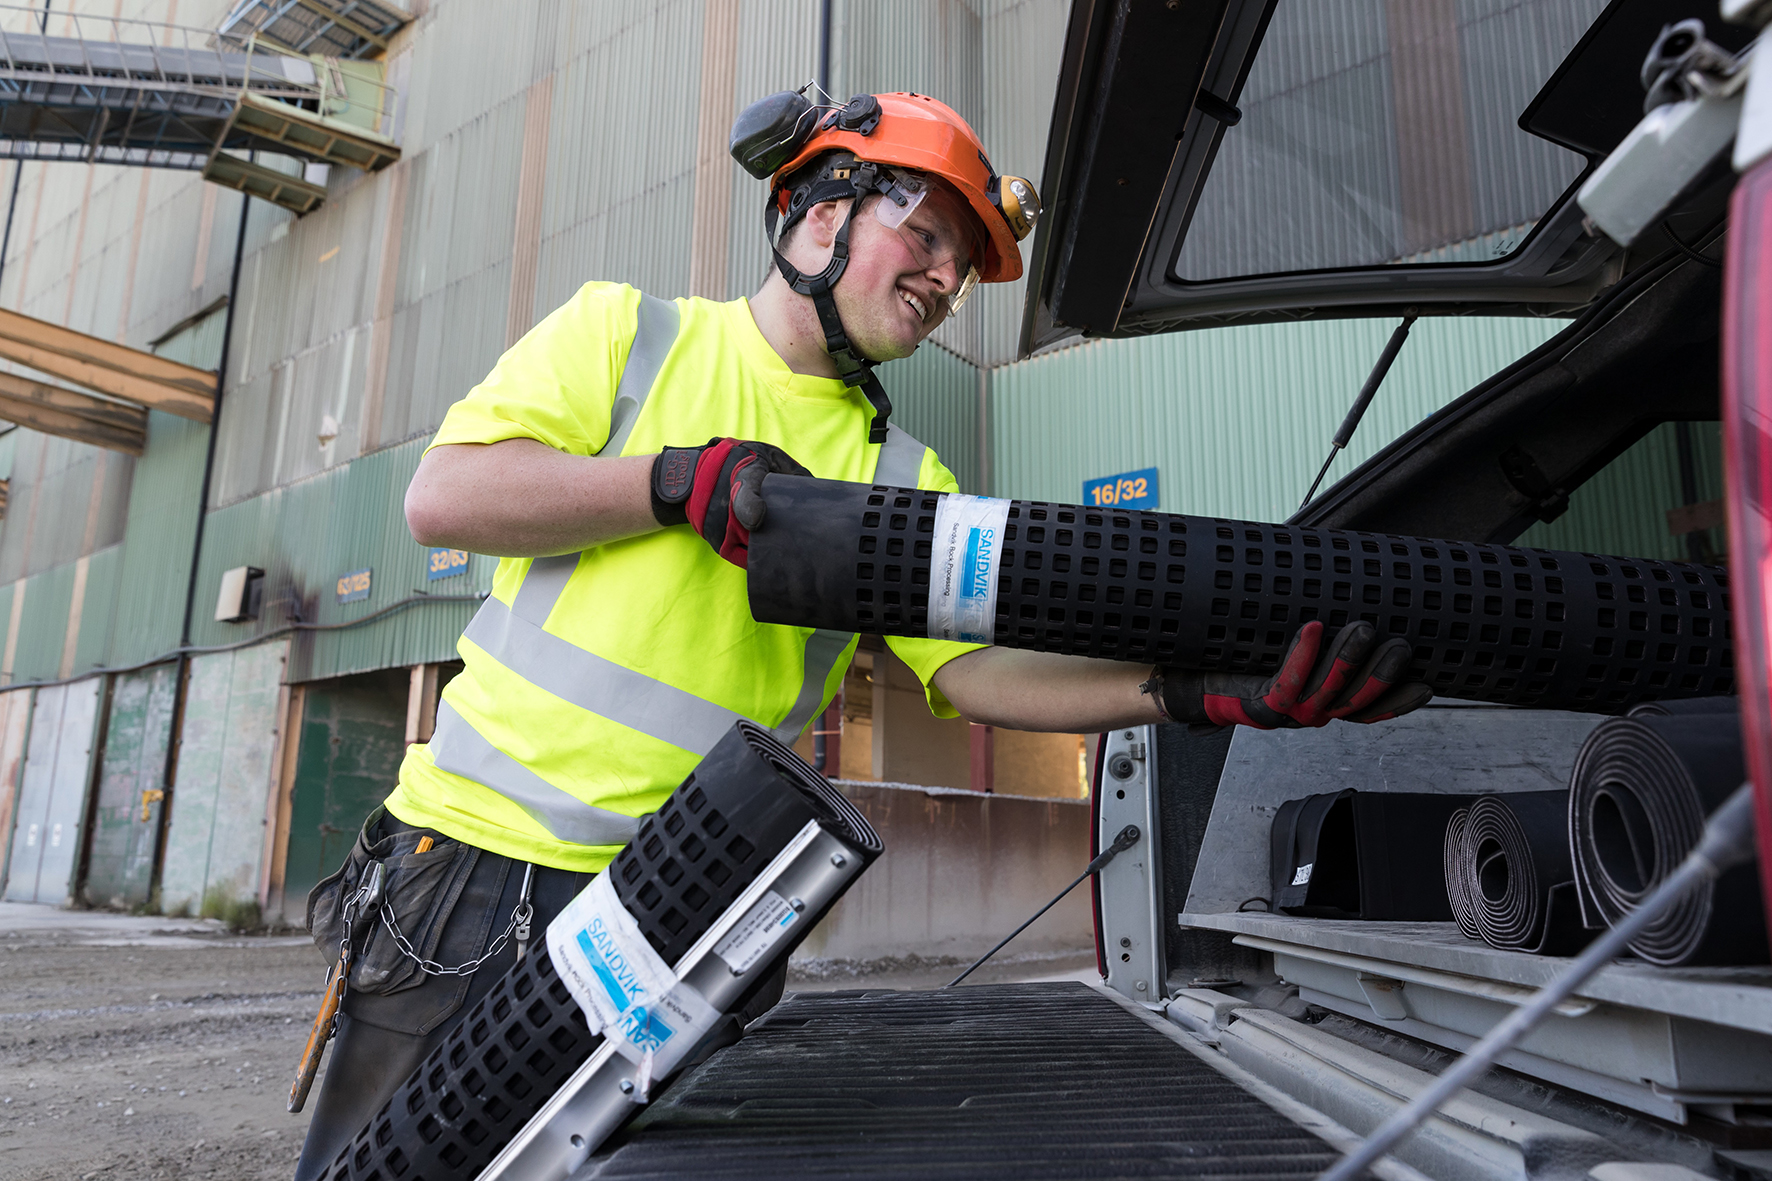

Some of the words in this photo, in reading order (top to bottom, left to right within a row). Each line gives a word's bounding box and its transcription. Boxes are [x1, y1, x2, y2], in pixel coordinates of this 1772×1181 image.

[1091, 478, 1148, 506] 16/32
[951, 522, 960, 546] Sandvik
[430, 550, 469, 573] 32/63
[948, 546, 956, 562] Rock
[974, 529, 994, 598] SANDVIK
[944, 563, 954, 597] Processing
[588, 917, 645, 1001] SANDVIK
[618, 1016, 661, 1053] SAN
